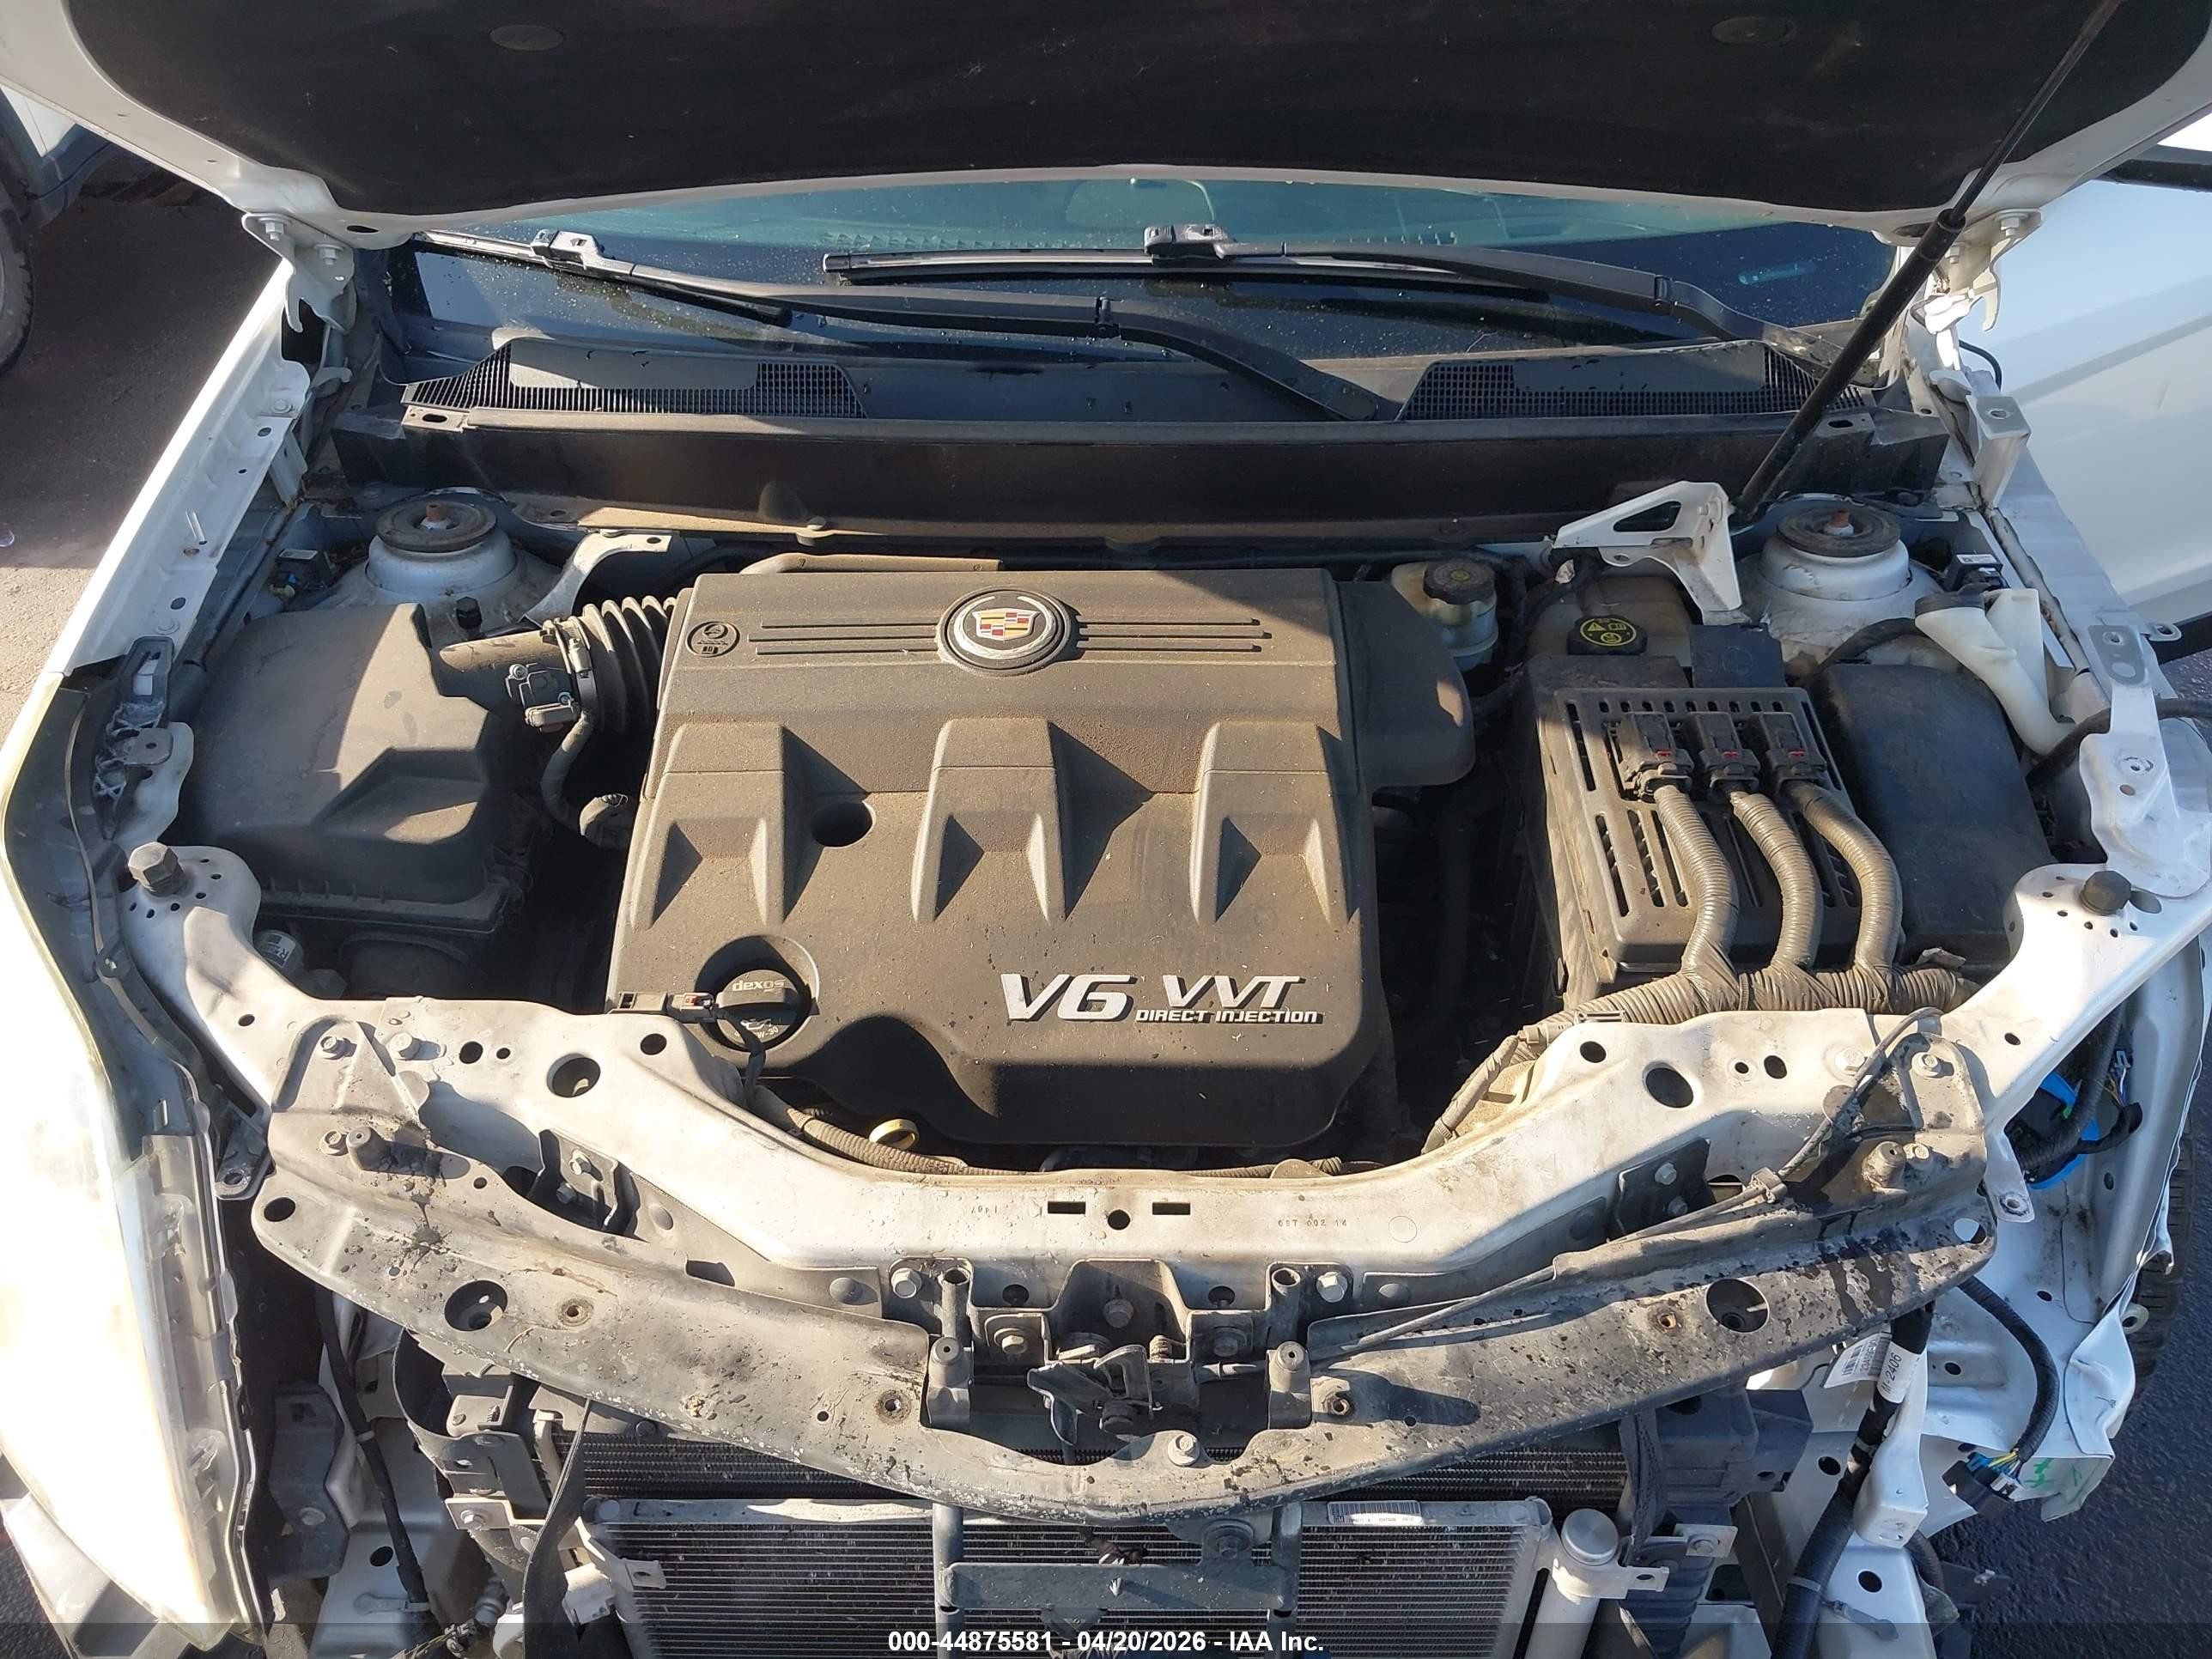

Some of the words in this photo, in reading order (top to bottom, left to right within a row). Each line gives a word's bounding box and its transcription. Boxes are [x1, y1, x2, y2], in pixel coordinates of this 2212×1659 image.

[732, 980, 785, 991] dexos
[1000, 974, 1132, 1020] V6
[1162, 975, 1301, 1008] VVT
[1135, 1010, 1212, 1023] DIRECT
[1215, 1010, 1320, 1023] INJECTION
